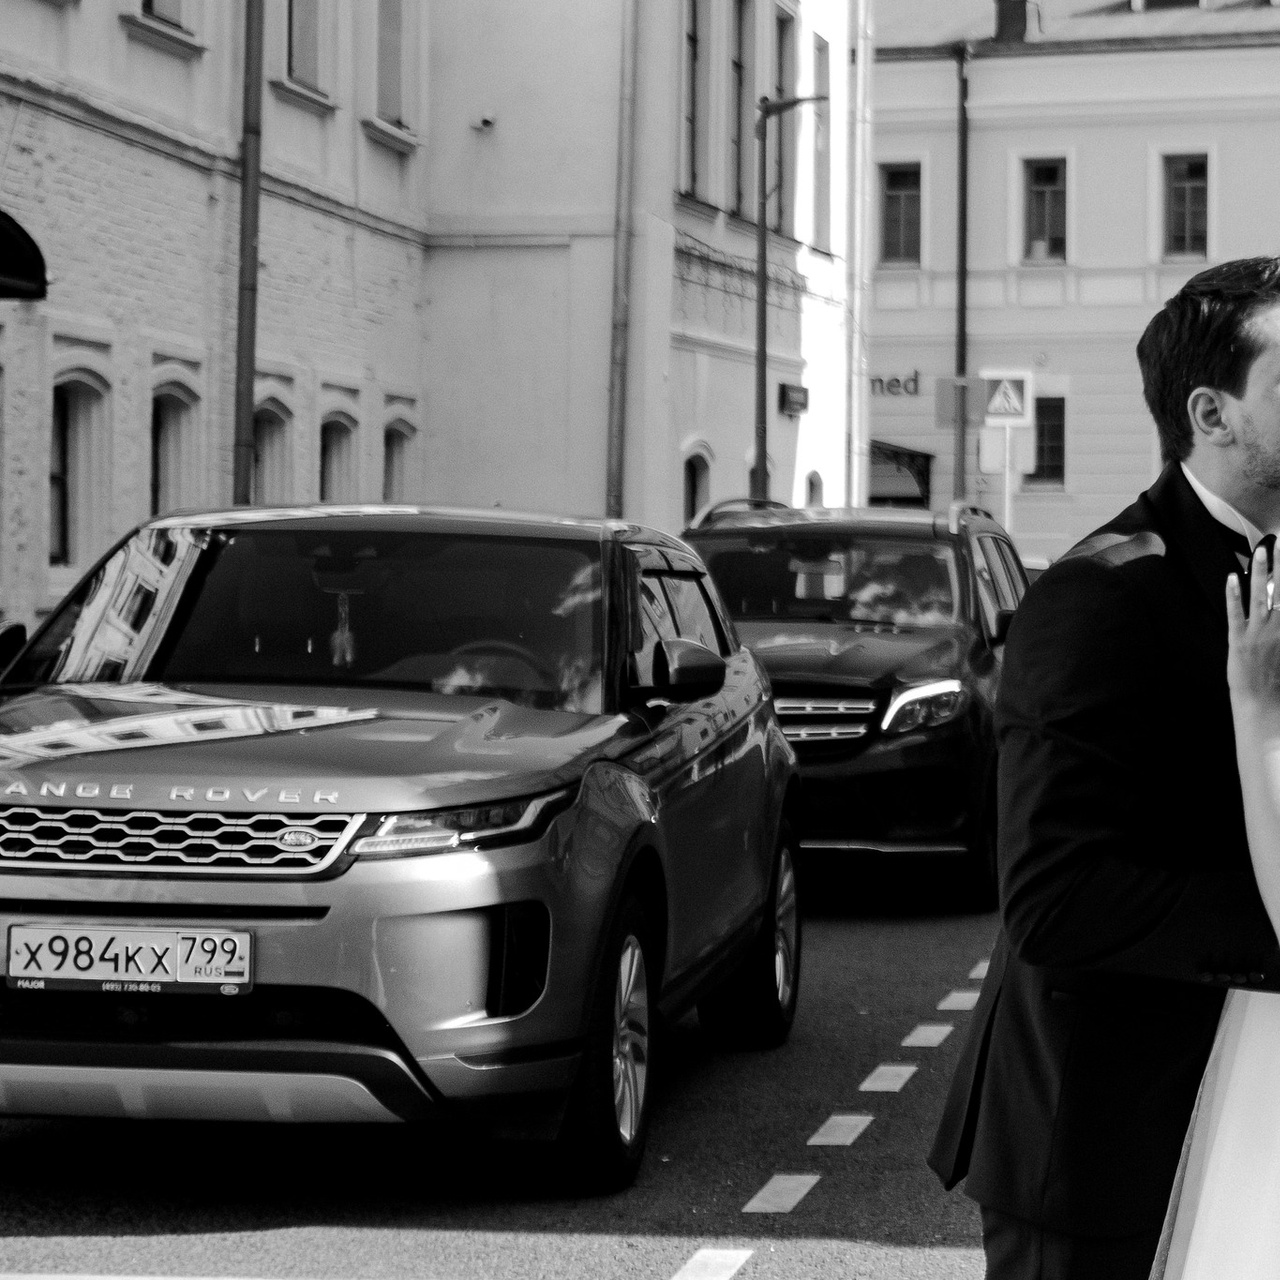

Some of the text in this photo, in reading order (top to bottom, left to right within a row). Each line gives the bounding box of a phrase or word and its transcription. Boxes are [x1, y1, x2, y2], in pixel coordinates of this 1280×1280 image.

[169, 785, 339, 805] ROVER
[181, 936, 238, 965] 799
[194, 966, 222, 978] RUS
